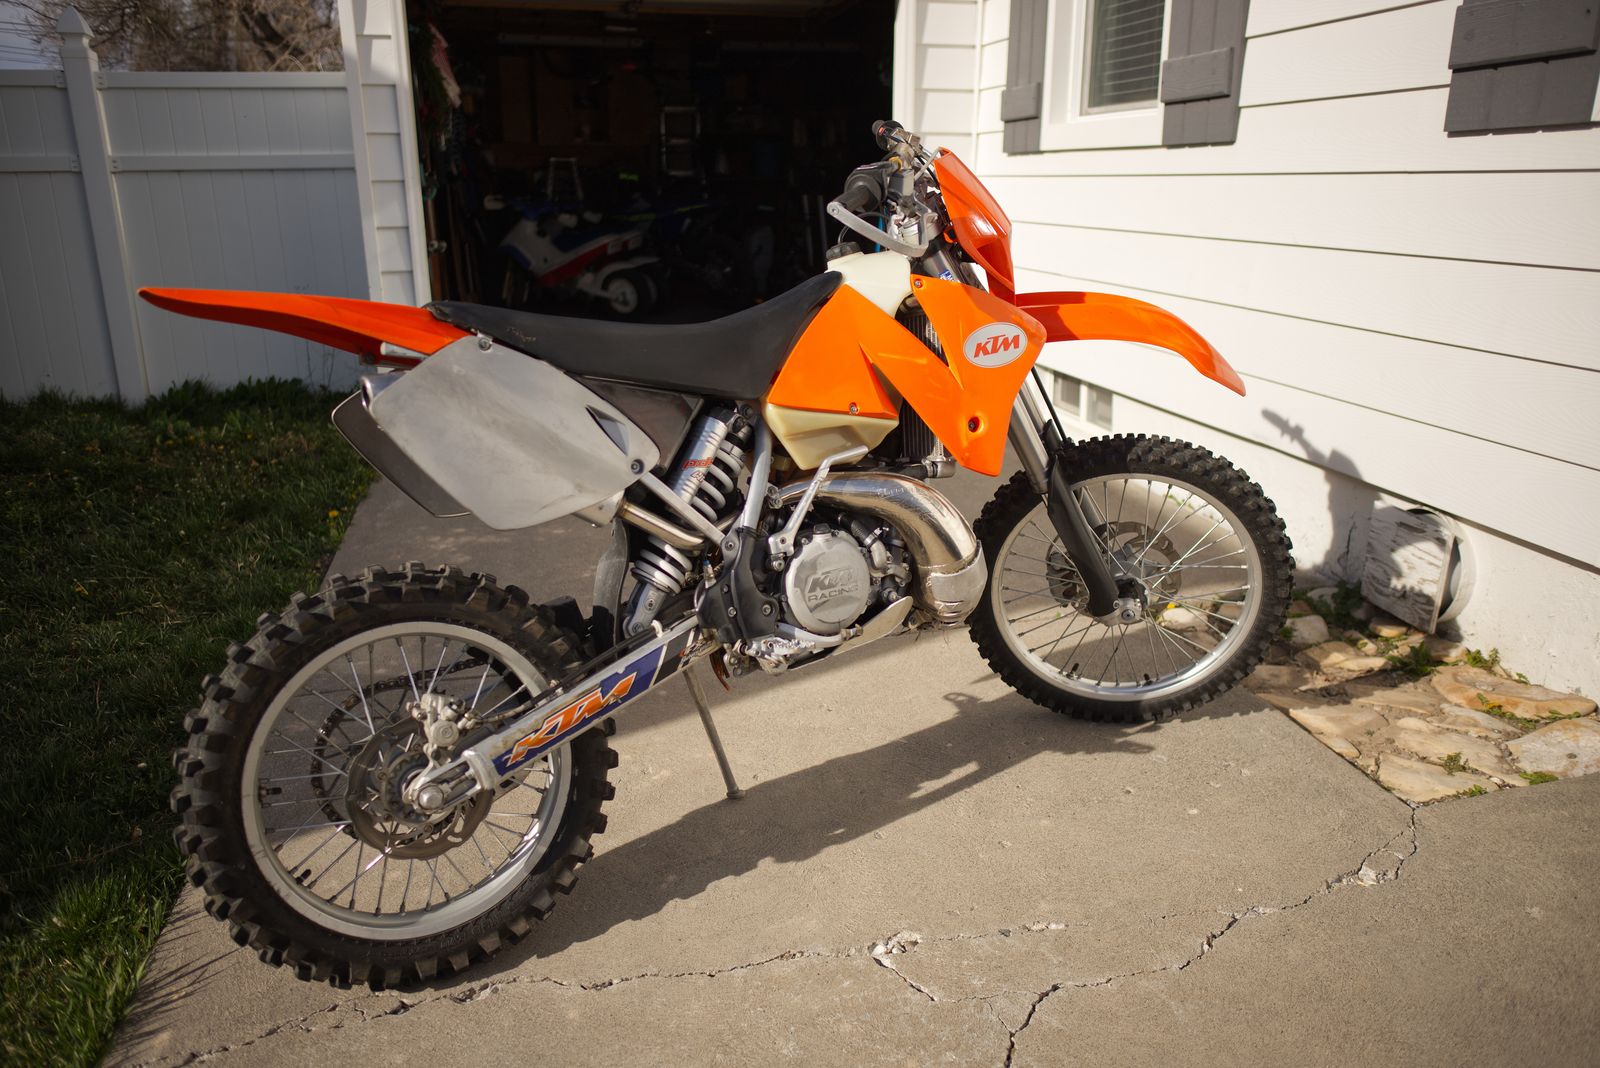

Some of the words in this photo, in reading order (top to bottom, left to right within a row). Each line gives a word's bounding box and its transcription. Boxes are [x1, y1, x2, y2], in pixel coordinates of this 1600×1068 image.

[973, 334, 1020, 358] KTM
[808, 583, 859, 602] RACING
[505, 672, 637, 767] KTM
